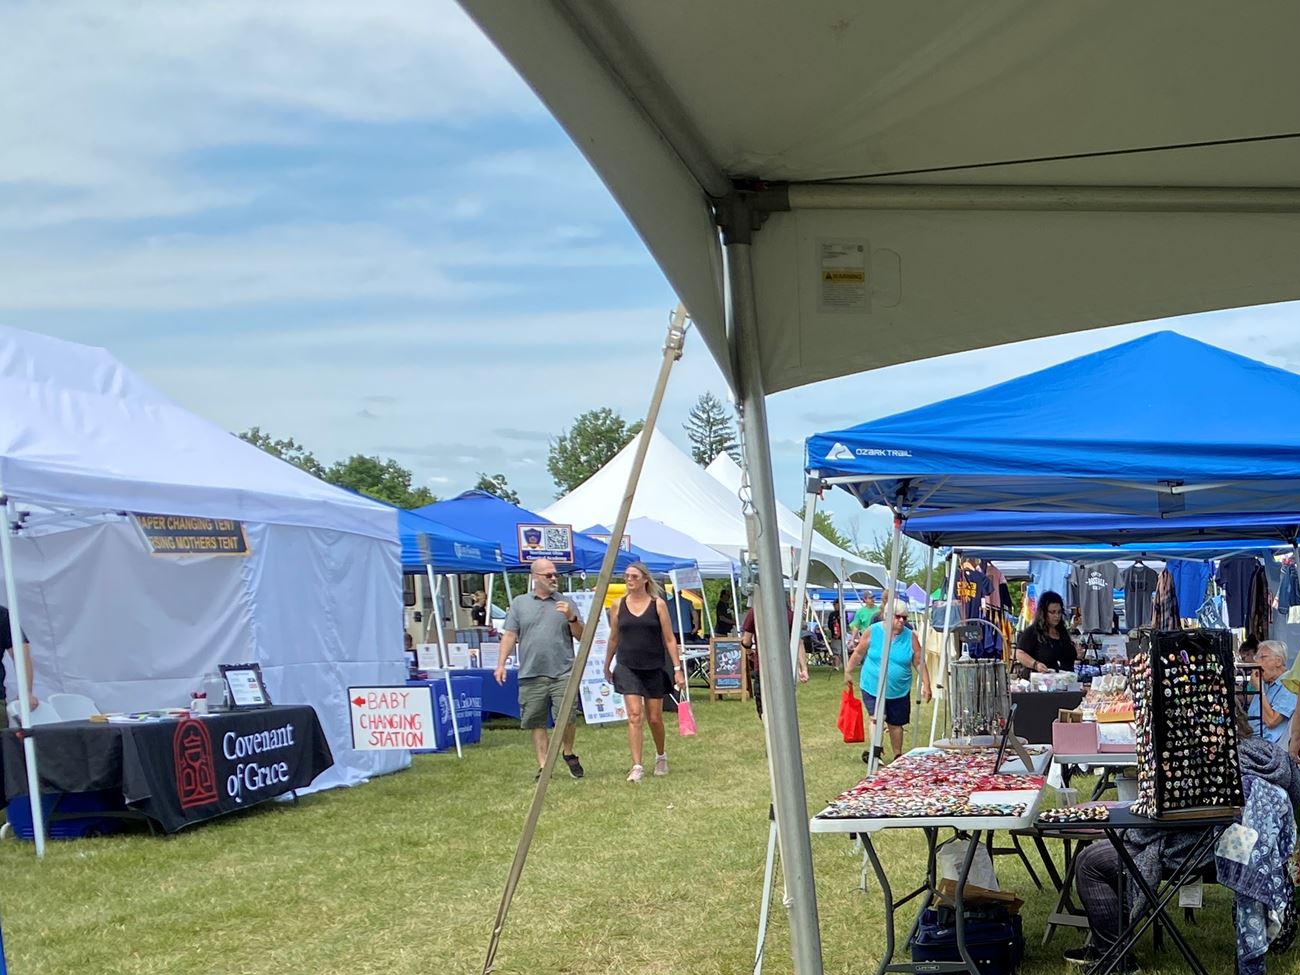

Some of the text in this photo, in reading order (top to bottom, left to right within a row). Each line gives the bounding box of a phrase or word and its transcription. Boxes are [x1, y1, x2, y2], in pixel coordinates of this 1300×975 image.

[856, 448, 912, 457] OZARK TRAIL
[168, 516, 212, 530] CHANGING
[215, 520, 235, 530] TENT
[176, 536, 216, 549] MOTHERS
[218, 537, 238, 549] TENT
[367, 692, 410, 710] BABY
[360, 714, 422, 730] CHANGING
[223, 723, 294, 760] Covenant
[368, 730, 424, 748] STATION
[226, 760, 290, 803] of Grace
